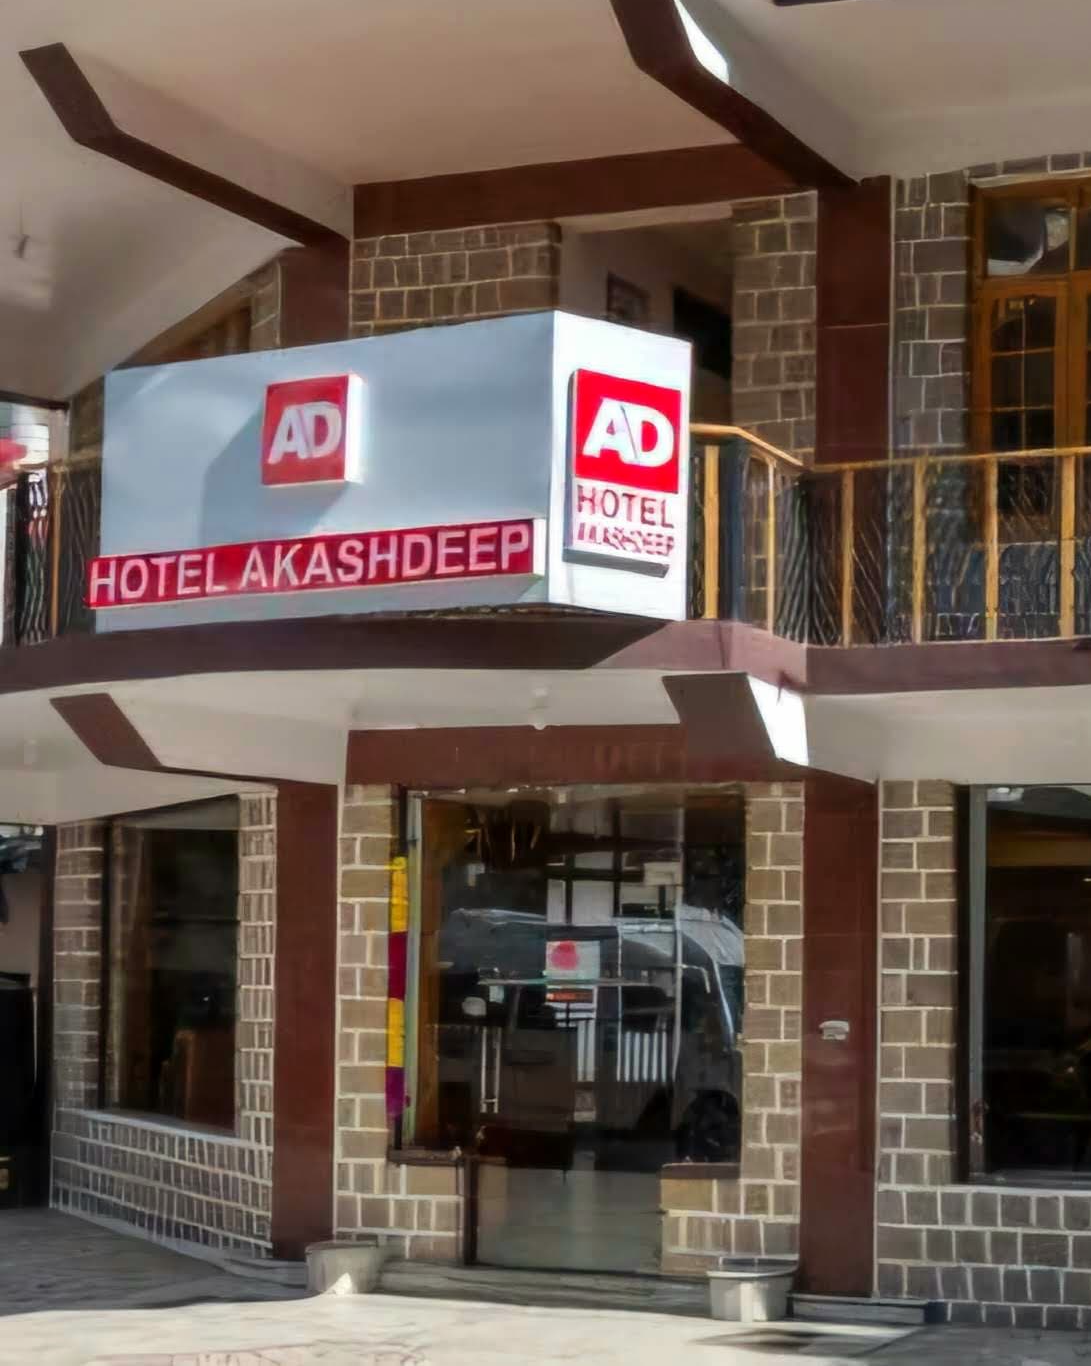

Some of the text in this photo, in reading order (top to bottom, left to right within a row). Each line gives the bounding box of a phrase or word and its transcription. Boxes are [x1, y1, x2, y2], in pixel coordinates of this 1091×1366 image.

[267, 400, 342, 464] AD
[582, 397, 675, 468] AD
[576, 484, 675, 529] HOTEL
[89, 552, 227, 604] HOTEL
[239, 522, 531, 590] AKASHDEEP
